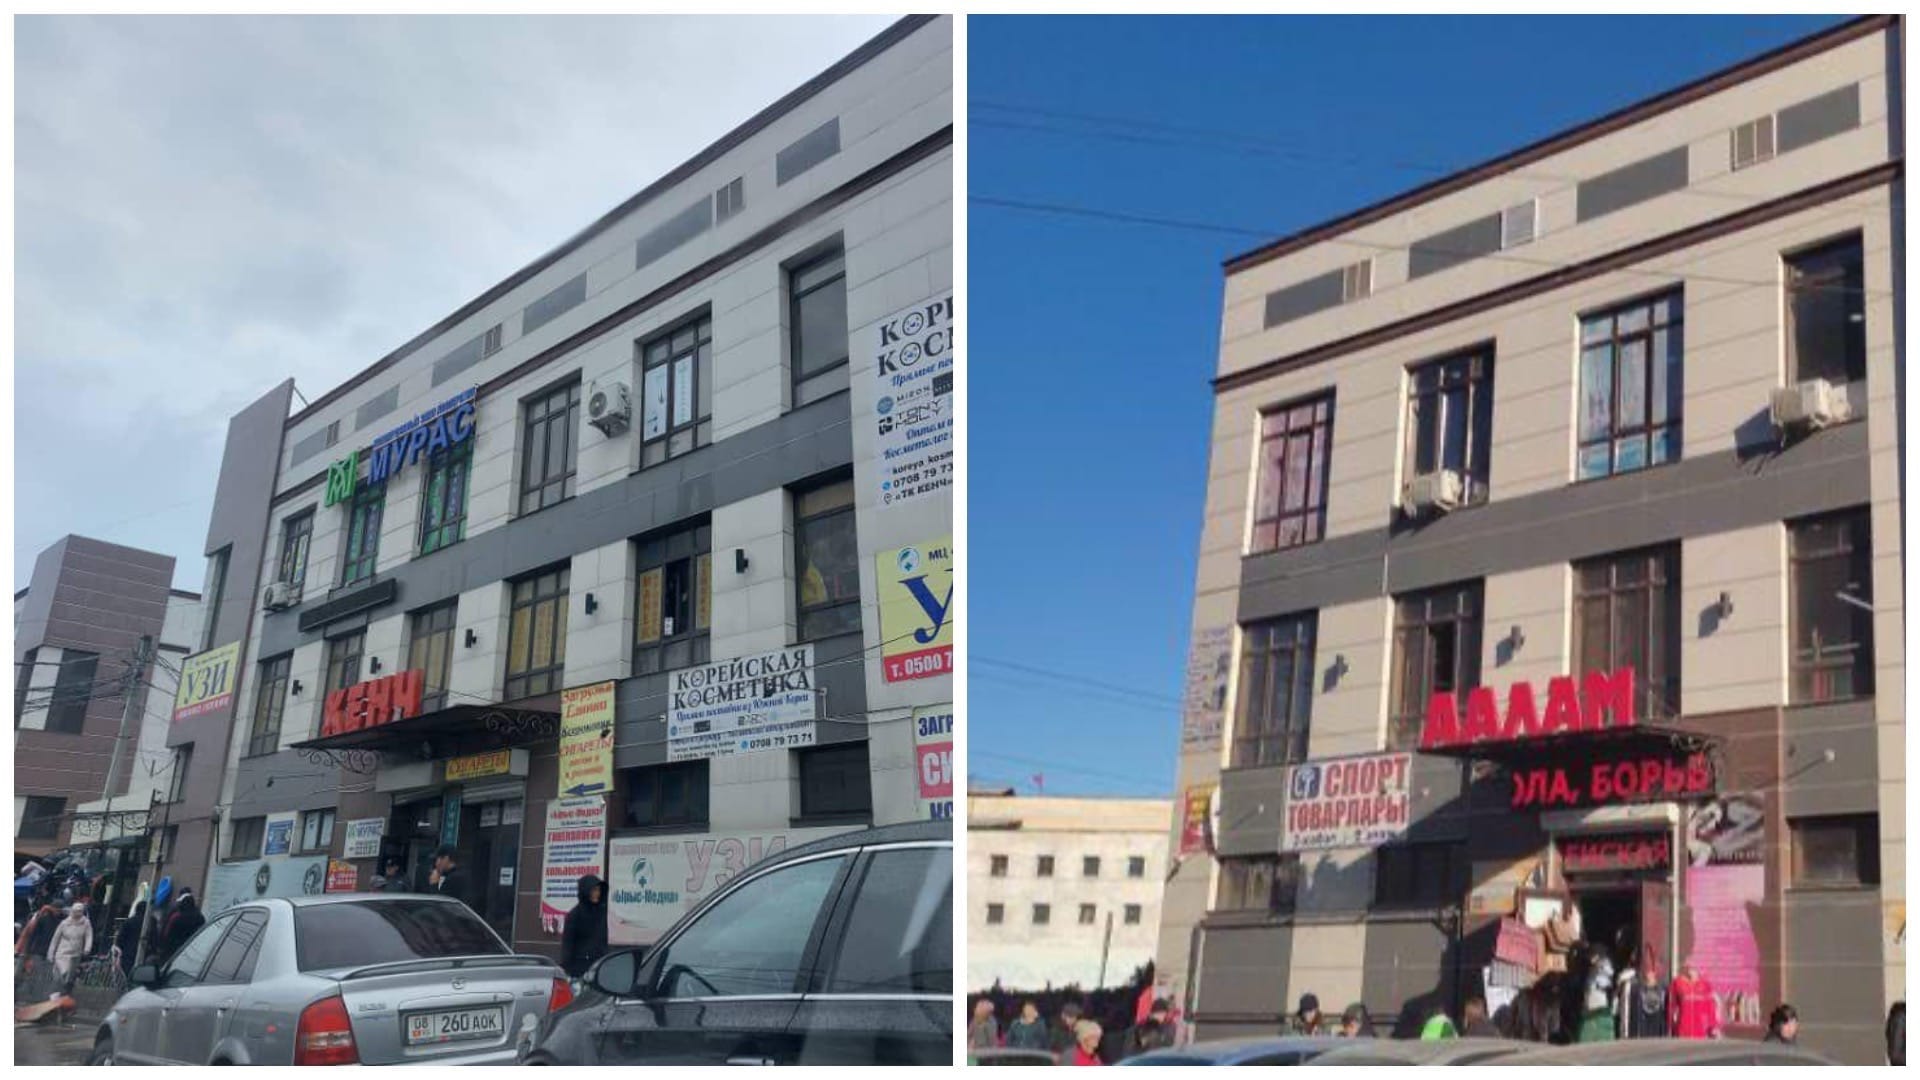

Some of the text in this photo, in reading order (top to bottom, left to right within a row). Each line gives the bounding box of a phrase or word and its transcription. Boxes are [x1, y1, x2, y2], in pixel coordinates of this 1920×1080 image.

[367, 403, 475, 486] МУРАС
[923, 468, 936, 479] 79
[183, 660, 230, 704] УЗИ
[677, 648, 806, 690] КОРЕЙСКАЯ
[905, 653, 943, 674] 0500
[321, 668, 424, 737] КЕНЧ
[674, 669, 809, 710] КОСМЕТИКА
[1421, 662, 1635, 749] ДАЛАМ
[750, 732, 812, 749] 0708 79 73 71
[1324, 755, 1410, 797] СПОРТ
[1288, 794, 1408, 833] ТОВАРЛАРЫ
[414, 1017, 429, 1030] 08
[441, 1013, 469, 1033] 260
